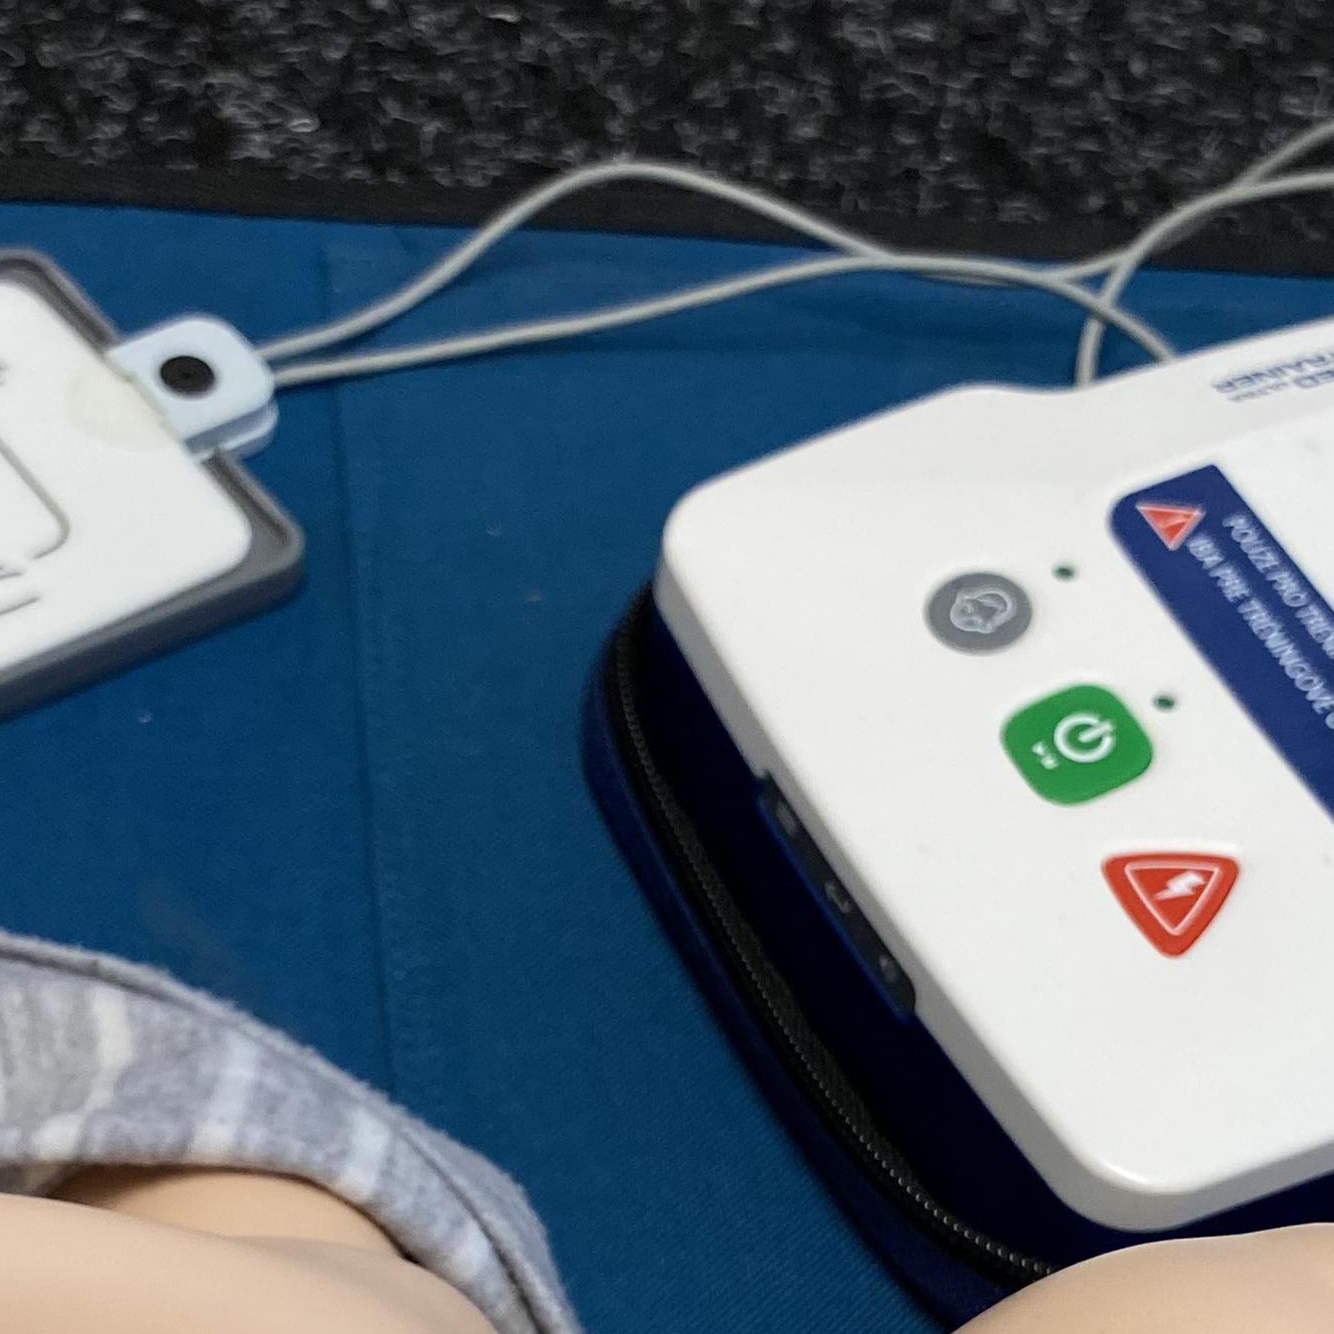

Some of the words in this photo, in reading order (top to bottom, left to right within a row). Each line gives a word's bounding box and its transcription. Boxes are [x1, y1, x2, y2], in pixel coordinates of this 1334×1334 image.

[1187, 533, 1225, 570] IBA
[1208, 563, 1251, 604] PRE
[1221, 513, 1283, 574] POUZE
[1266, 570, 1310, 608] PRO
